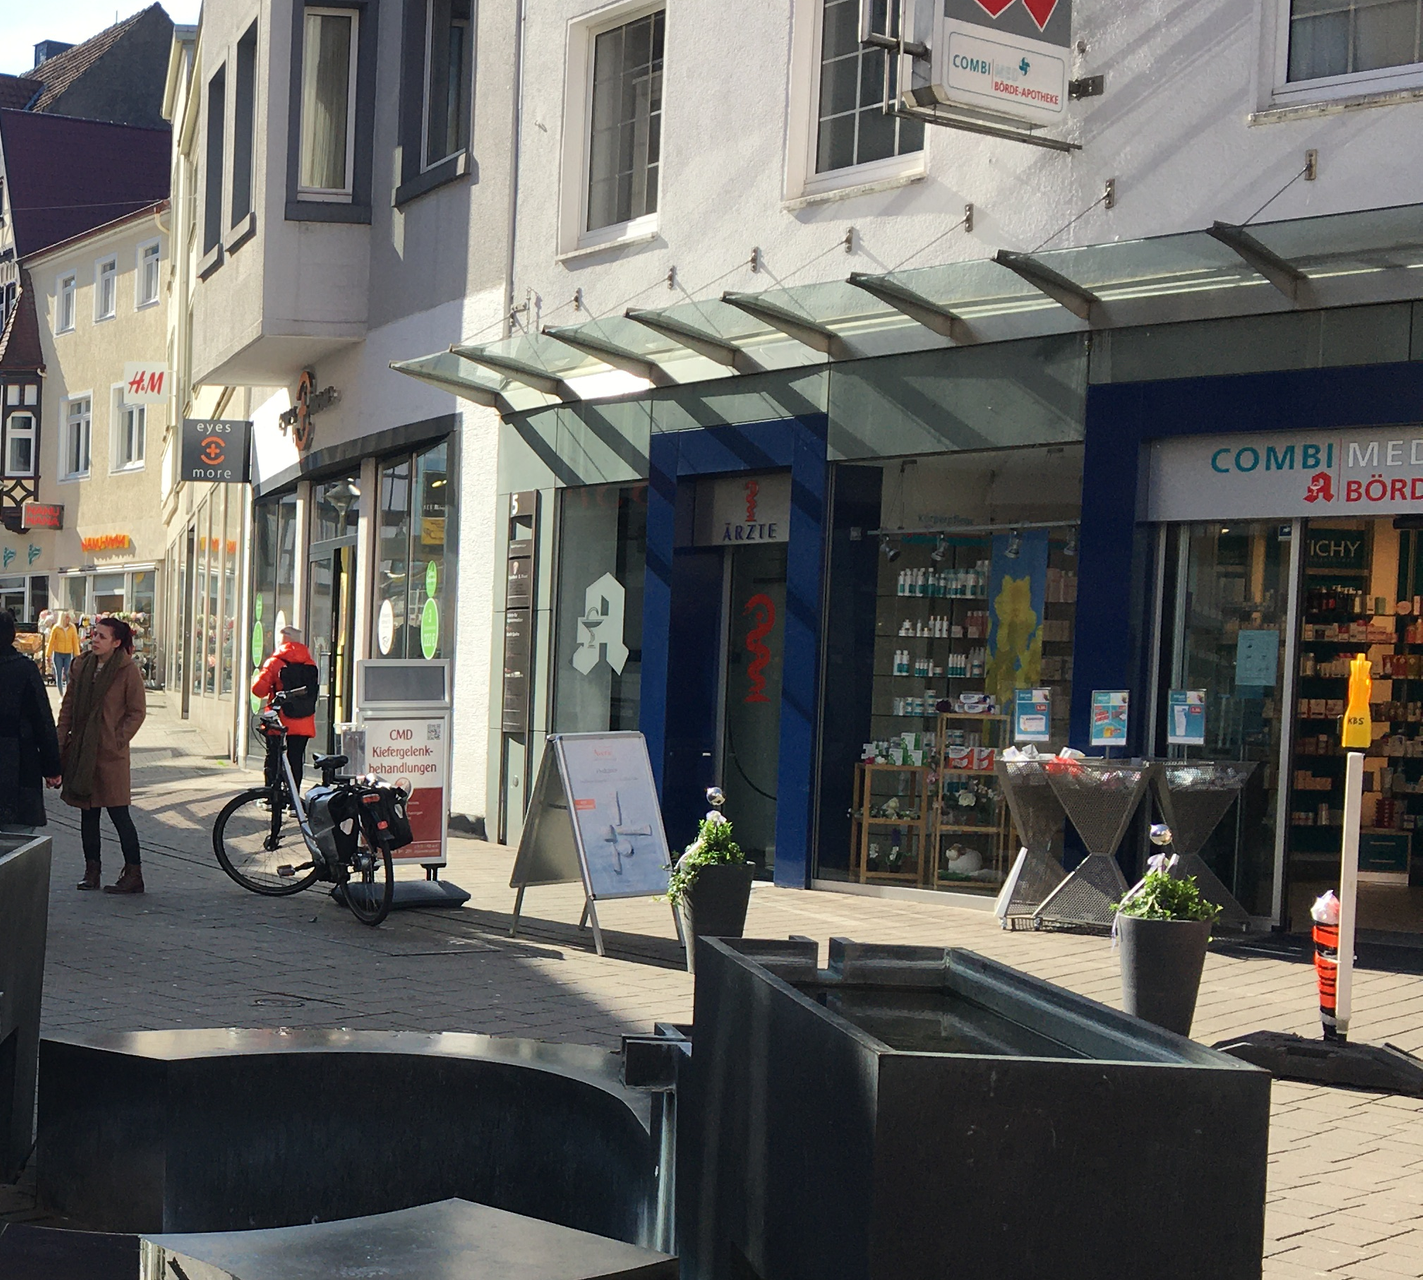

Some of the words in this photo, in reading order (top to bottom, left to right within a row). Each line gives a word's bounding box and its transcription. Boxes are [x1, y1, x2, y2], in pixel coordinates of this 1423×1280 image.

[953, 53, 991, 76] COMBI
[994, 63, 1019, 83] MED
[994, 80, 1059, 105] BÖRDE-APOTHEKE
[127, 370, 165, 395] H&M
[196, 422, 232, 435] eyes
[1211, 442, 1334, 473] COMBI
[192, 468, 232, 479] more
[26, 505, 60, 516] NANU
[511, 493, 519, 515] 5
[26, 515, 60, 527] NANA
[722, 522, 777, 542] ÄRZTE
[1307, 540, 1361, 557] ICHY
[389, 729, 414, 741] CMD
[372, 745, 434, 760] Kiefergelenk-
[368, 762, 437, 775] behandlungen
